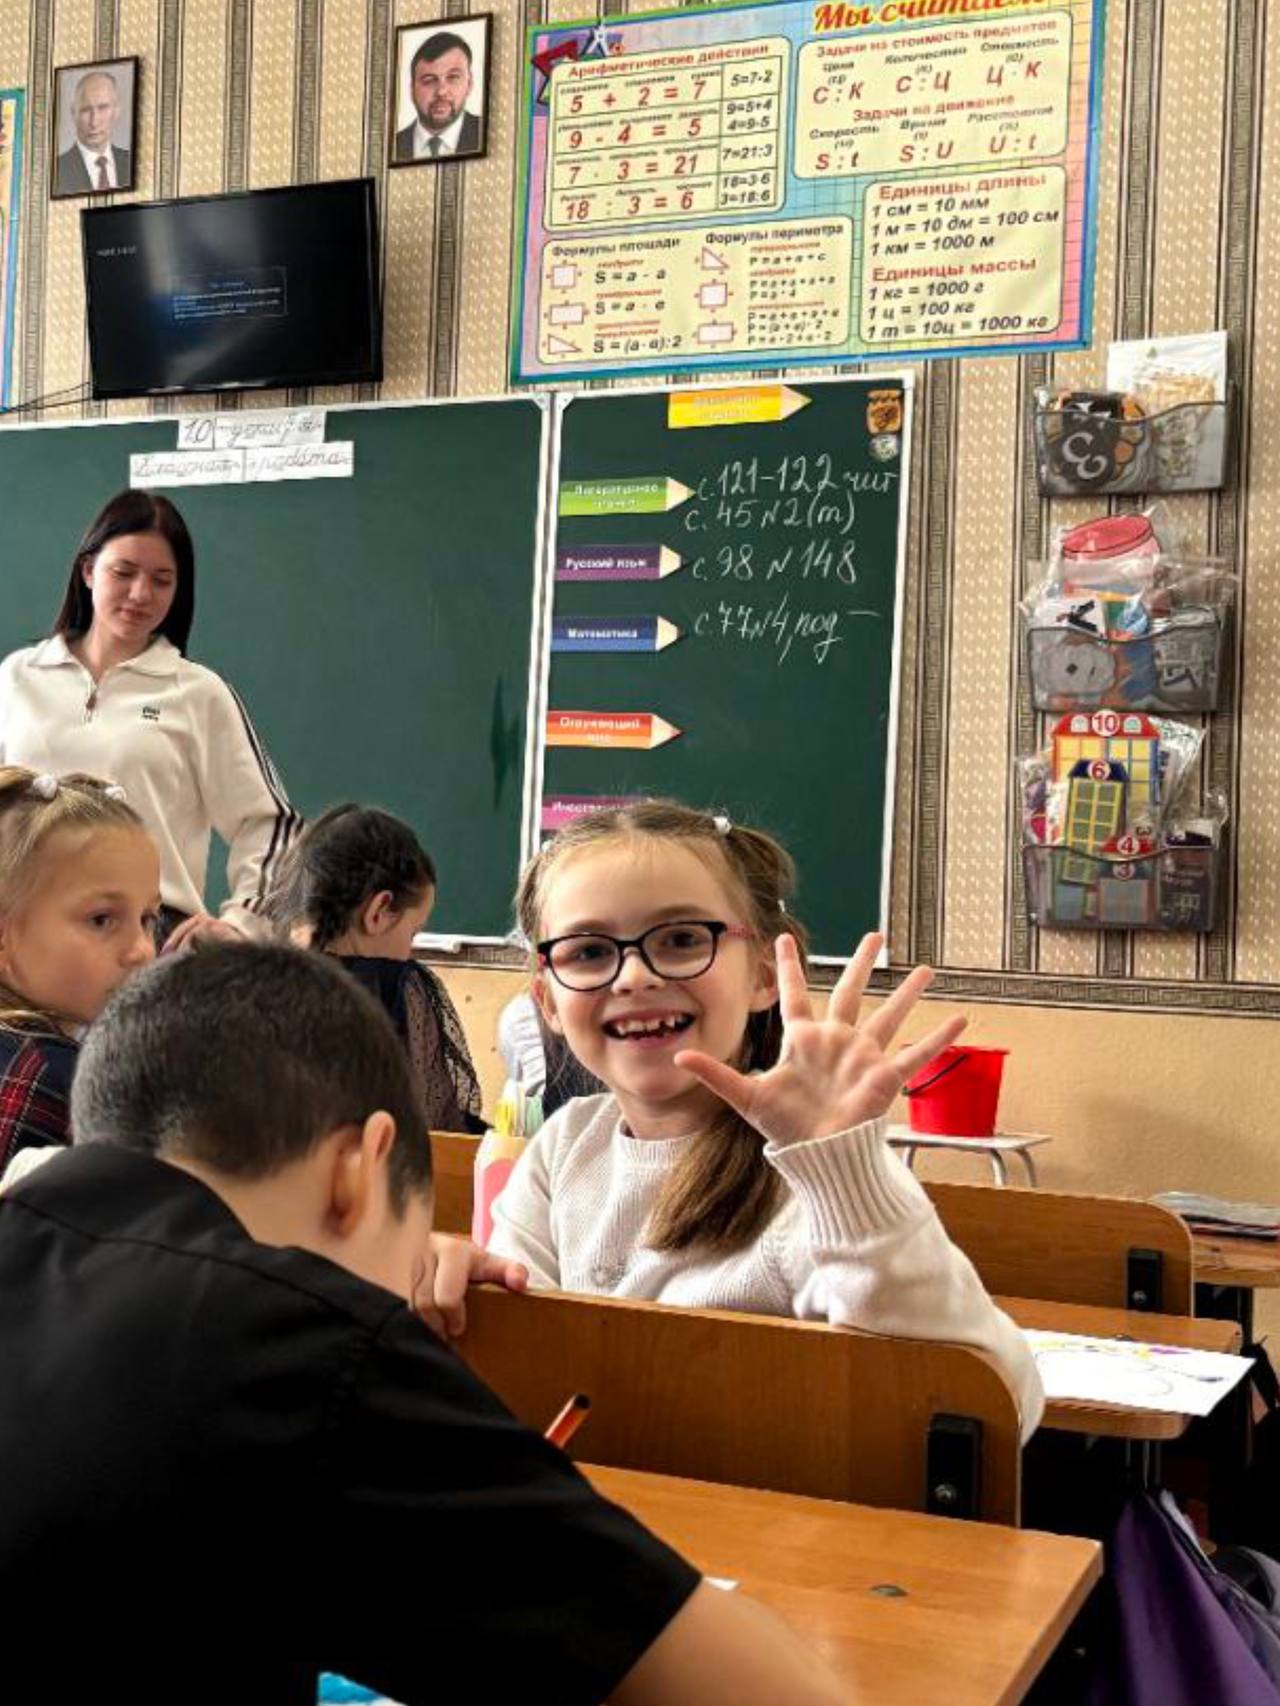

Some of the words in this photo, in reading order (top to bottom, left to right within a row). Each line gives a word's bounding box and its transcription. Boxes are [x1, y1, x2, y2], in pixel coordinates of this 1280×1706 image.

[815, 2, 873, 32] Мы
[817, 43, 868, 58] Задачи
[892, 31, 971, 50] стоимость
[568, 54, 695, 79] Арифметические
[697, 44, 770, 66] действия
[1024, 60, 1042, 79] К
[812, 86, 830, 105] С
[848, 81, 866, 101] К
[896, 75, 913, 94] С
[570, 94, 584, 114] 5
[637, 87, 651, 106] 2
[693, 80, 707, 100] 7
[853, 106, 908, 123] Задачи
[935, 95, 1016, 114] движение
[569, 130, 583, 150] 9
[617, 123, 632, 145] 4
[687, 118, 702, 138] 5
[815, 154, 830, 171] S
[899, 145, 916, 163] S
[568, 166, 582, 185] 7
[616, 160, 630, 181] 3
[673, 154, 699, 175] 21
[878, 181, 970, 202] Единицы
[975, 173, 1048, 193] длины
[566, 200, 591, 220] 18
[627, 195, 642, 215] 3
[680, 191, 694, 211] 6
[886, 204, 913, 218] см
[935, 197, 957, 213] 10
[960, 198, 991, 211] мм
[705, 229, 769, 245] Формулы
[771, 223, 845, 240] периметра
[885, 223, 902, 237] м
[922, 218, 943, 234] 10
[947, 215, 974, 231] дм
[997, 211, 1029, 227] 100
[1032, 210, 1060, 224] см
[551, 243, 617, 258] Формулы
[619, 236, 681, 254] площади
[884, 242, 910, 256] км
[932, 235, 976, 251] 1000
[979, 235, 996, 248] м
[594, 270, 607, 284] S
[872, 262, 966, 283] Единицы
[970, 258, 1037, 275] массы
[882, 288, 904, 301] кг
[927, 281, 969, 297] 1000
[595, 301, 606, 315] S
[919, 301, 951, 317] 100
[953, 301, 976, 315] кг
[881, 325, 900, 338] т
[979, 315, 1022, 332] 1000
[1027, 316, 1050, 329] кг
[593, 339, 604, 354] S
[185, 419, 213, 444] 10
[716, 500, 759, 528] 45
[566, 558, 615, 571] Русский
[716, 544, 755, 581] 98
[567, 628, 638, 639] Математика
[1094, 714, 1118, 733] 10
[1092, 763, 1105, 778] 6
[1120, 838, 1134, 854] 4
